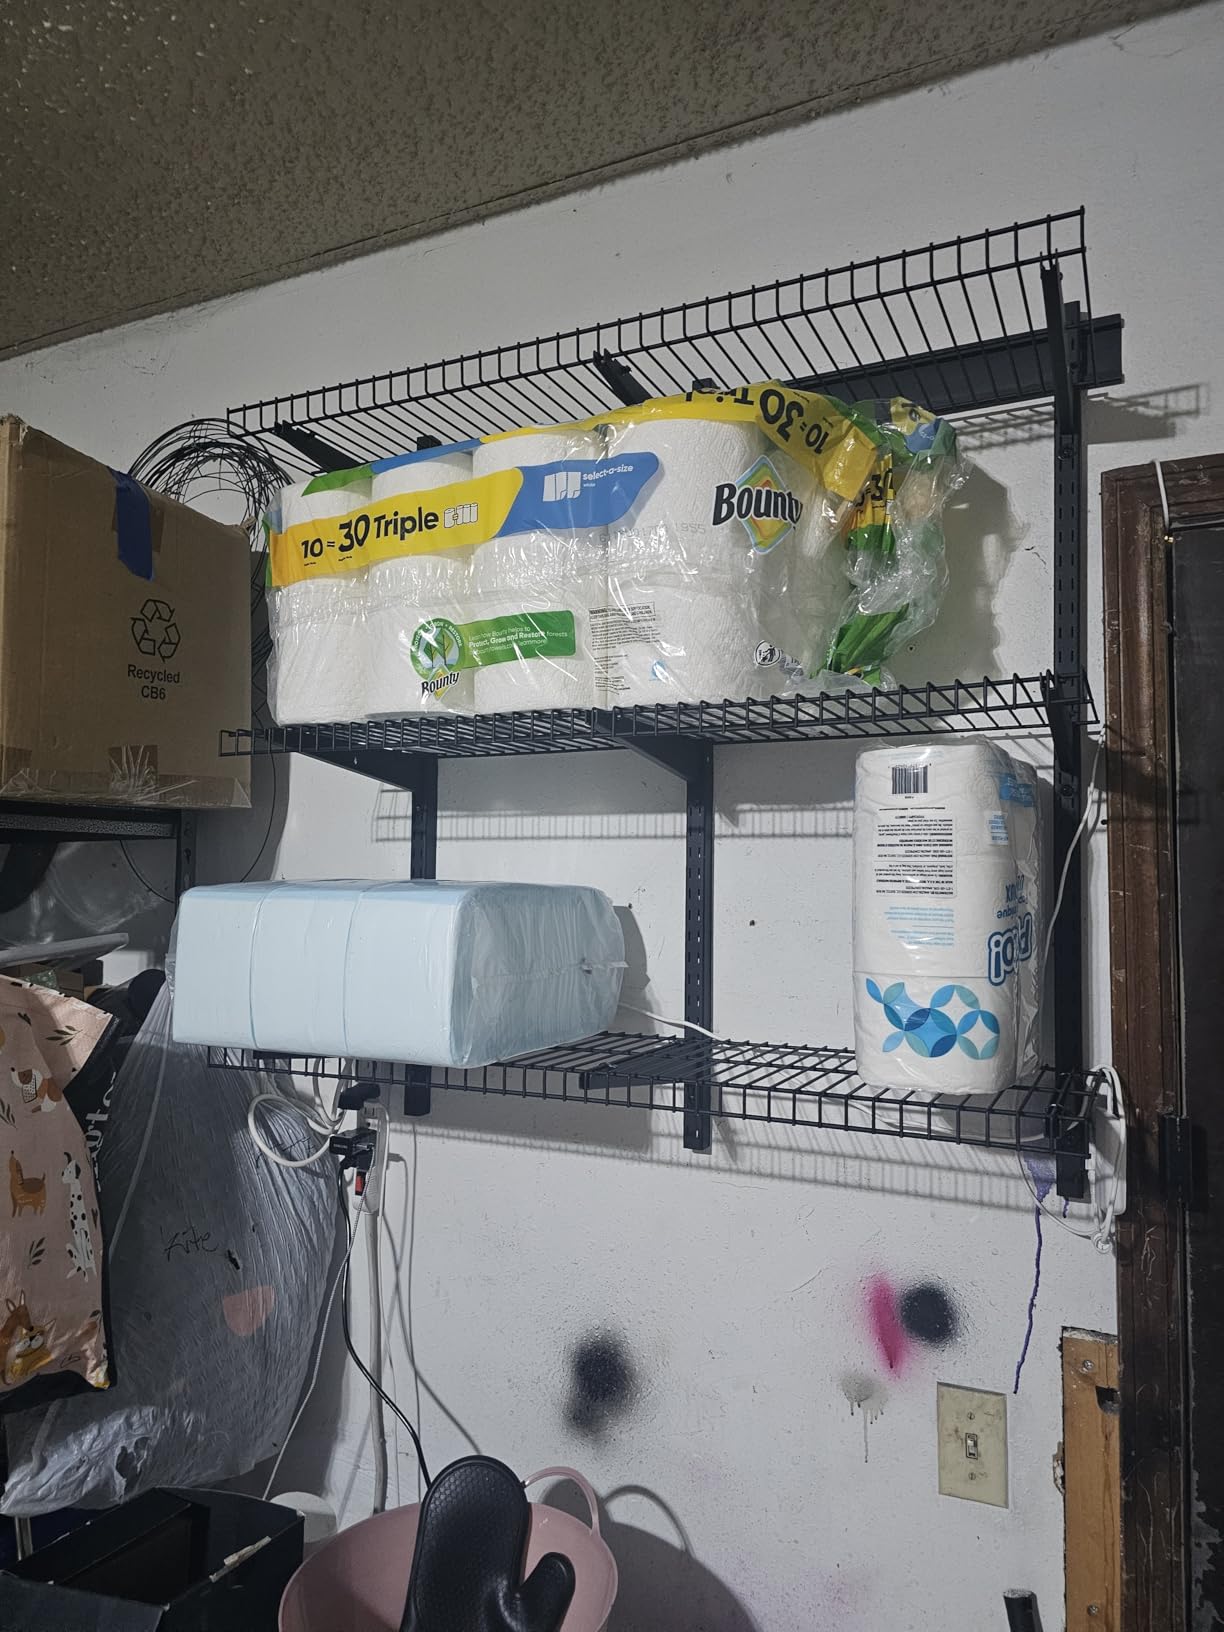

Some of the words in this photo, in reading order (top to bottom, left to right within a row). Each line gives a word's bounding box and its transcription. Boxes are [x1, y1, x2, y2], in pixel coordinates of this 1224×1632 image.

[760, 388, 804, 442] 30
[582, 463, 634, 481] select-a-size
[301, 537, 324, 559] 10
[338, 513, 371, 553] 30
[373, 506, 439, 541] Triple
[490, 636, 507, 644] Grow
[507, 633, 518, 641] and
[546, 630, 568, 638] forests
[127, 663, 181, 685] Recycled
[421, 671, 460, 696] Bounty
[140, 684, 166, 700] CB6
